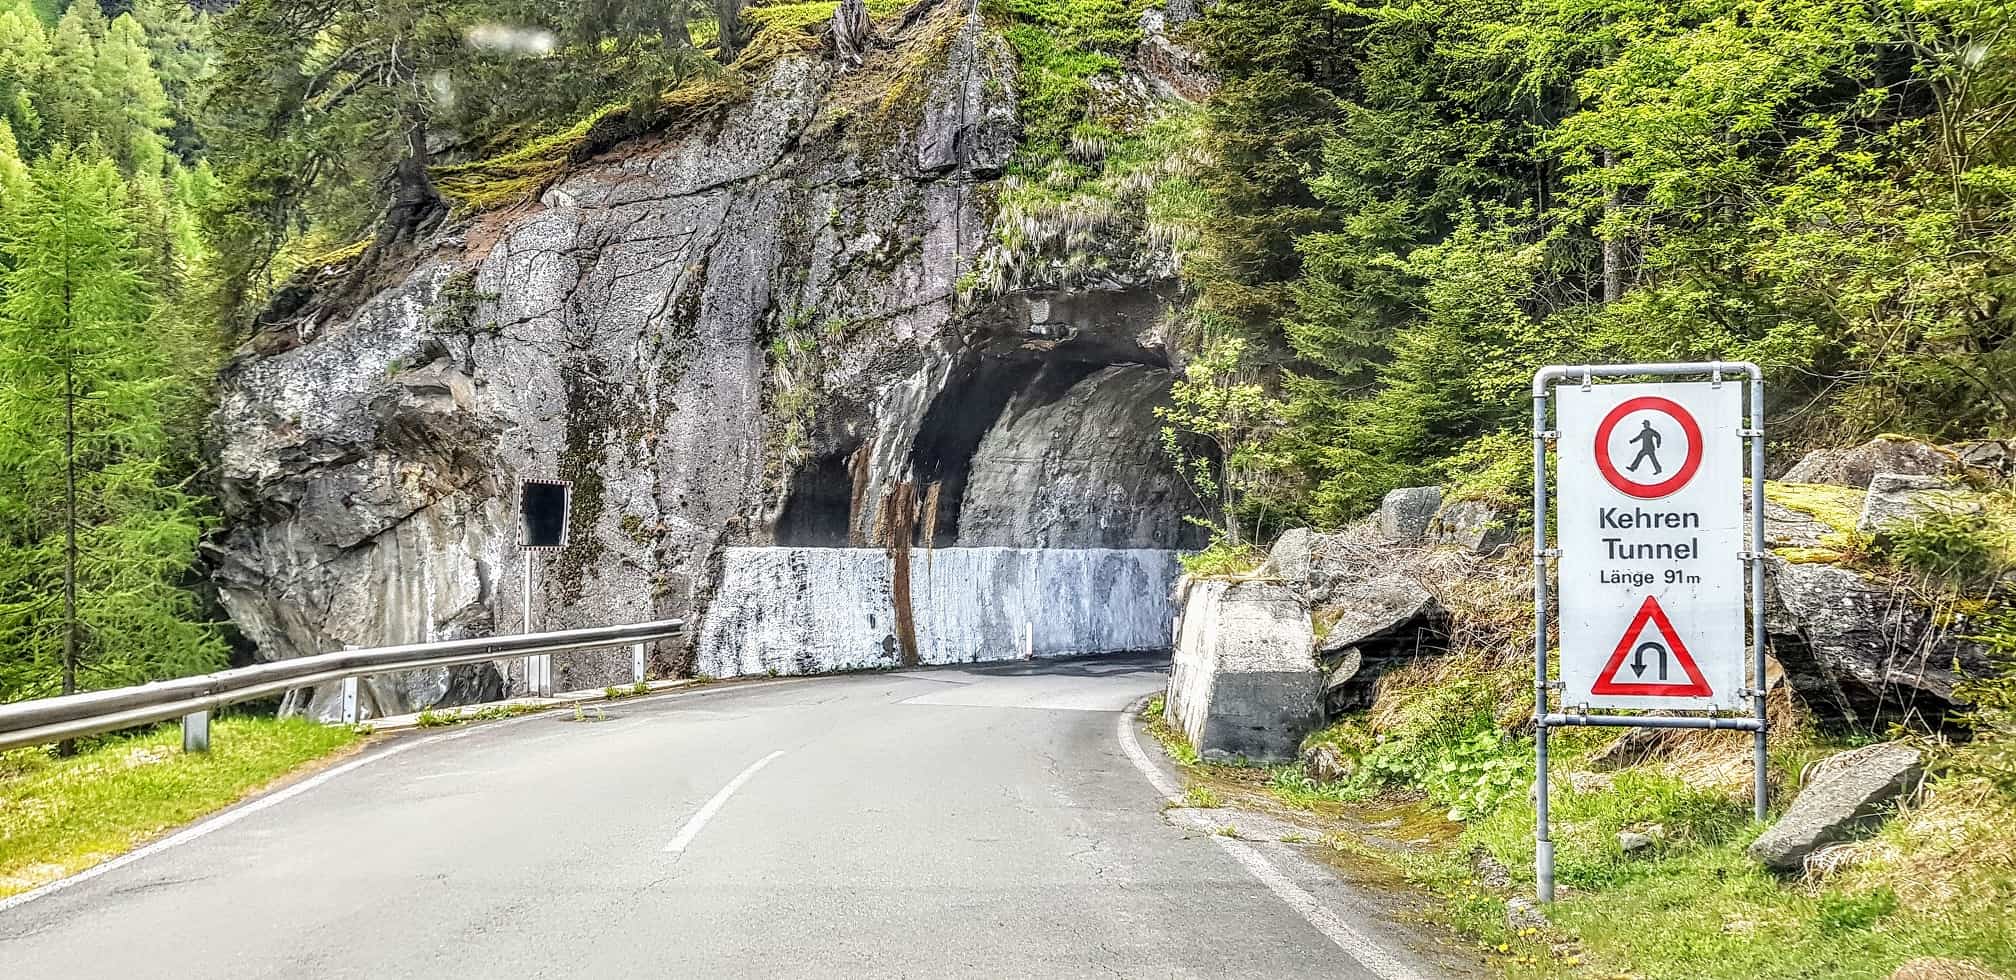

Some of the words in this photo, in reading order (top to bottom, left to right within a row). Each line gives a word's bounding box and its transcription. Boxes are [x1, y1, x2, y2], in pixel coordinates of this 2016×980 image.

[1599, 507, 1699, 529] Kehren
[1602, 537, 1698, 560] Tunnel
[1600, 569, 1655, 587] Länge
